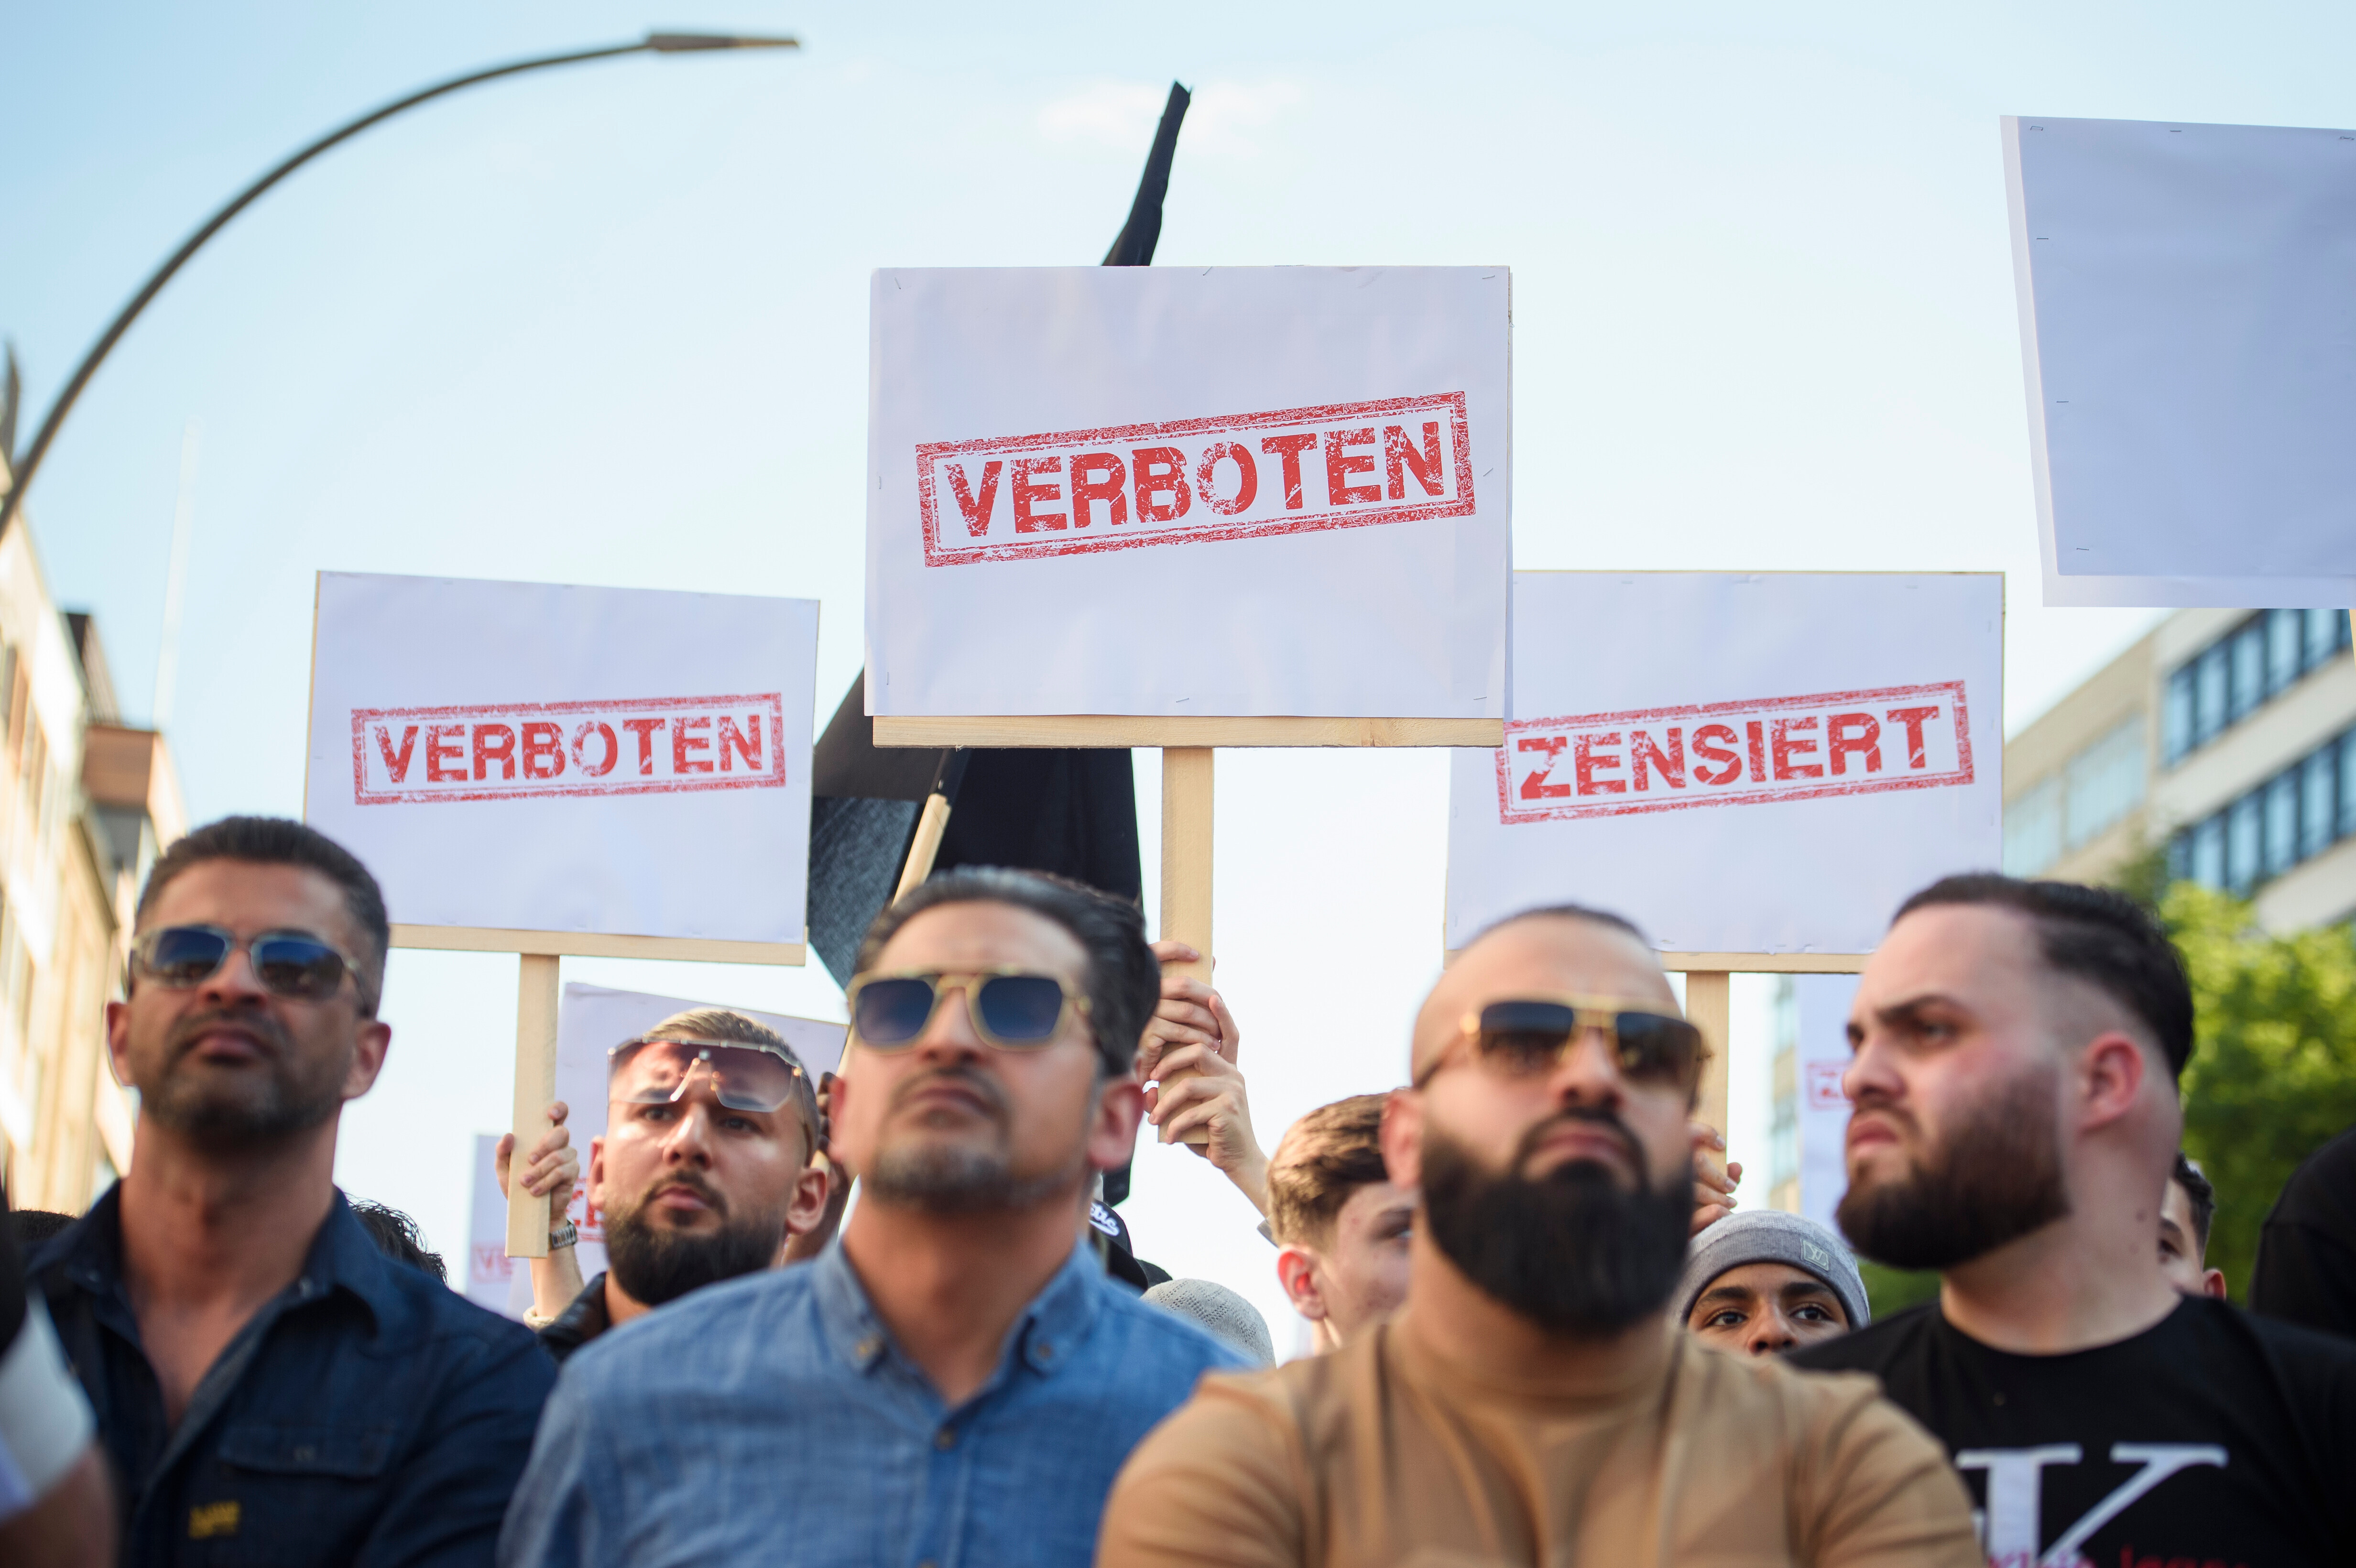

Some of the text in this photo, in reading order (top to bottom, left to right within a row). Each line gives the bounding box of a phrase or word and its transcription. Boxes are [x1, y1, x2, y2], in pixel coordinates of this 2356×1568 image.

[944, 421, 1445, 537] VERBOTEN
[373, 714, 763, 784] VERBOTEN
[1517, 706, 1940, 800] ZENSIERT
